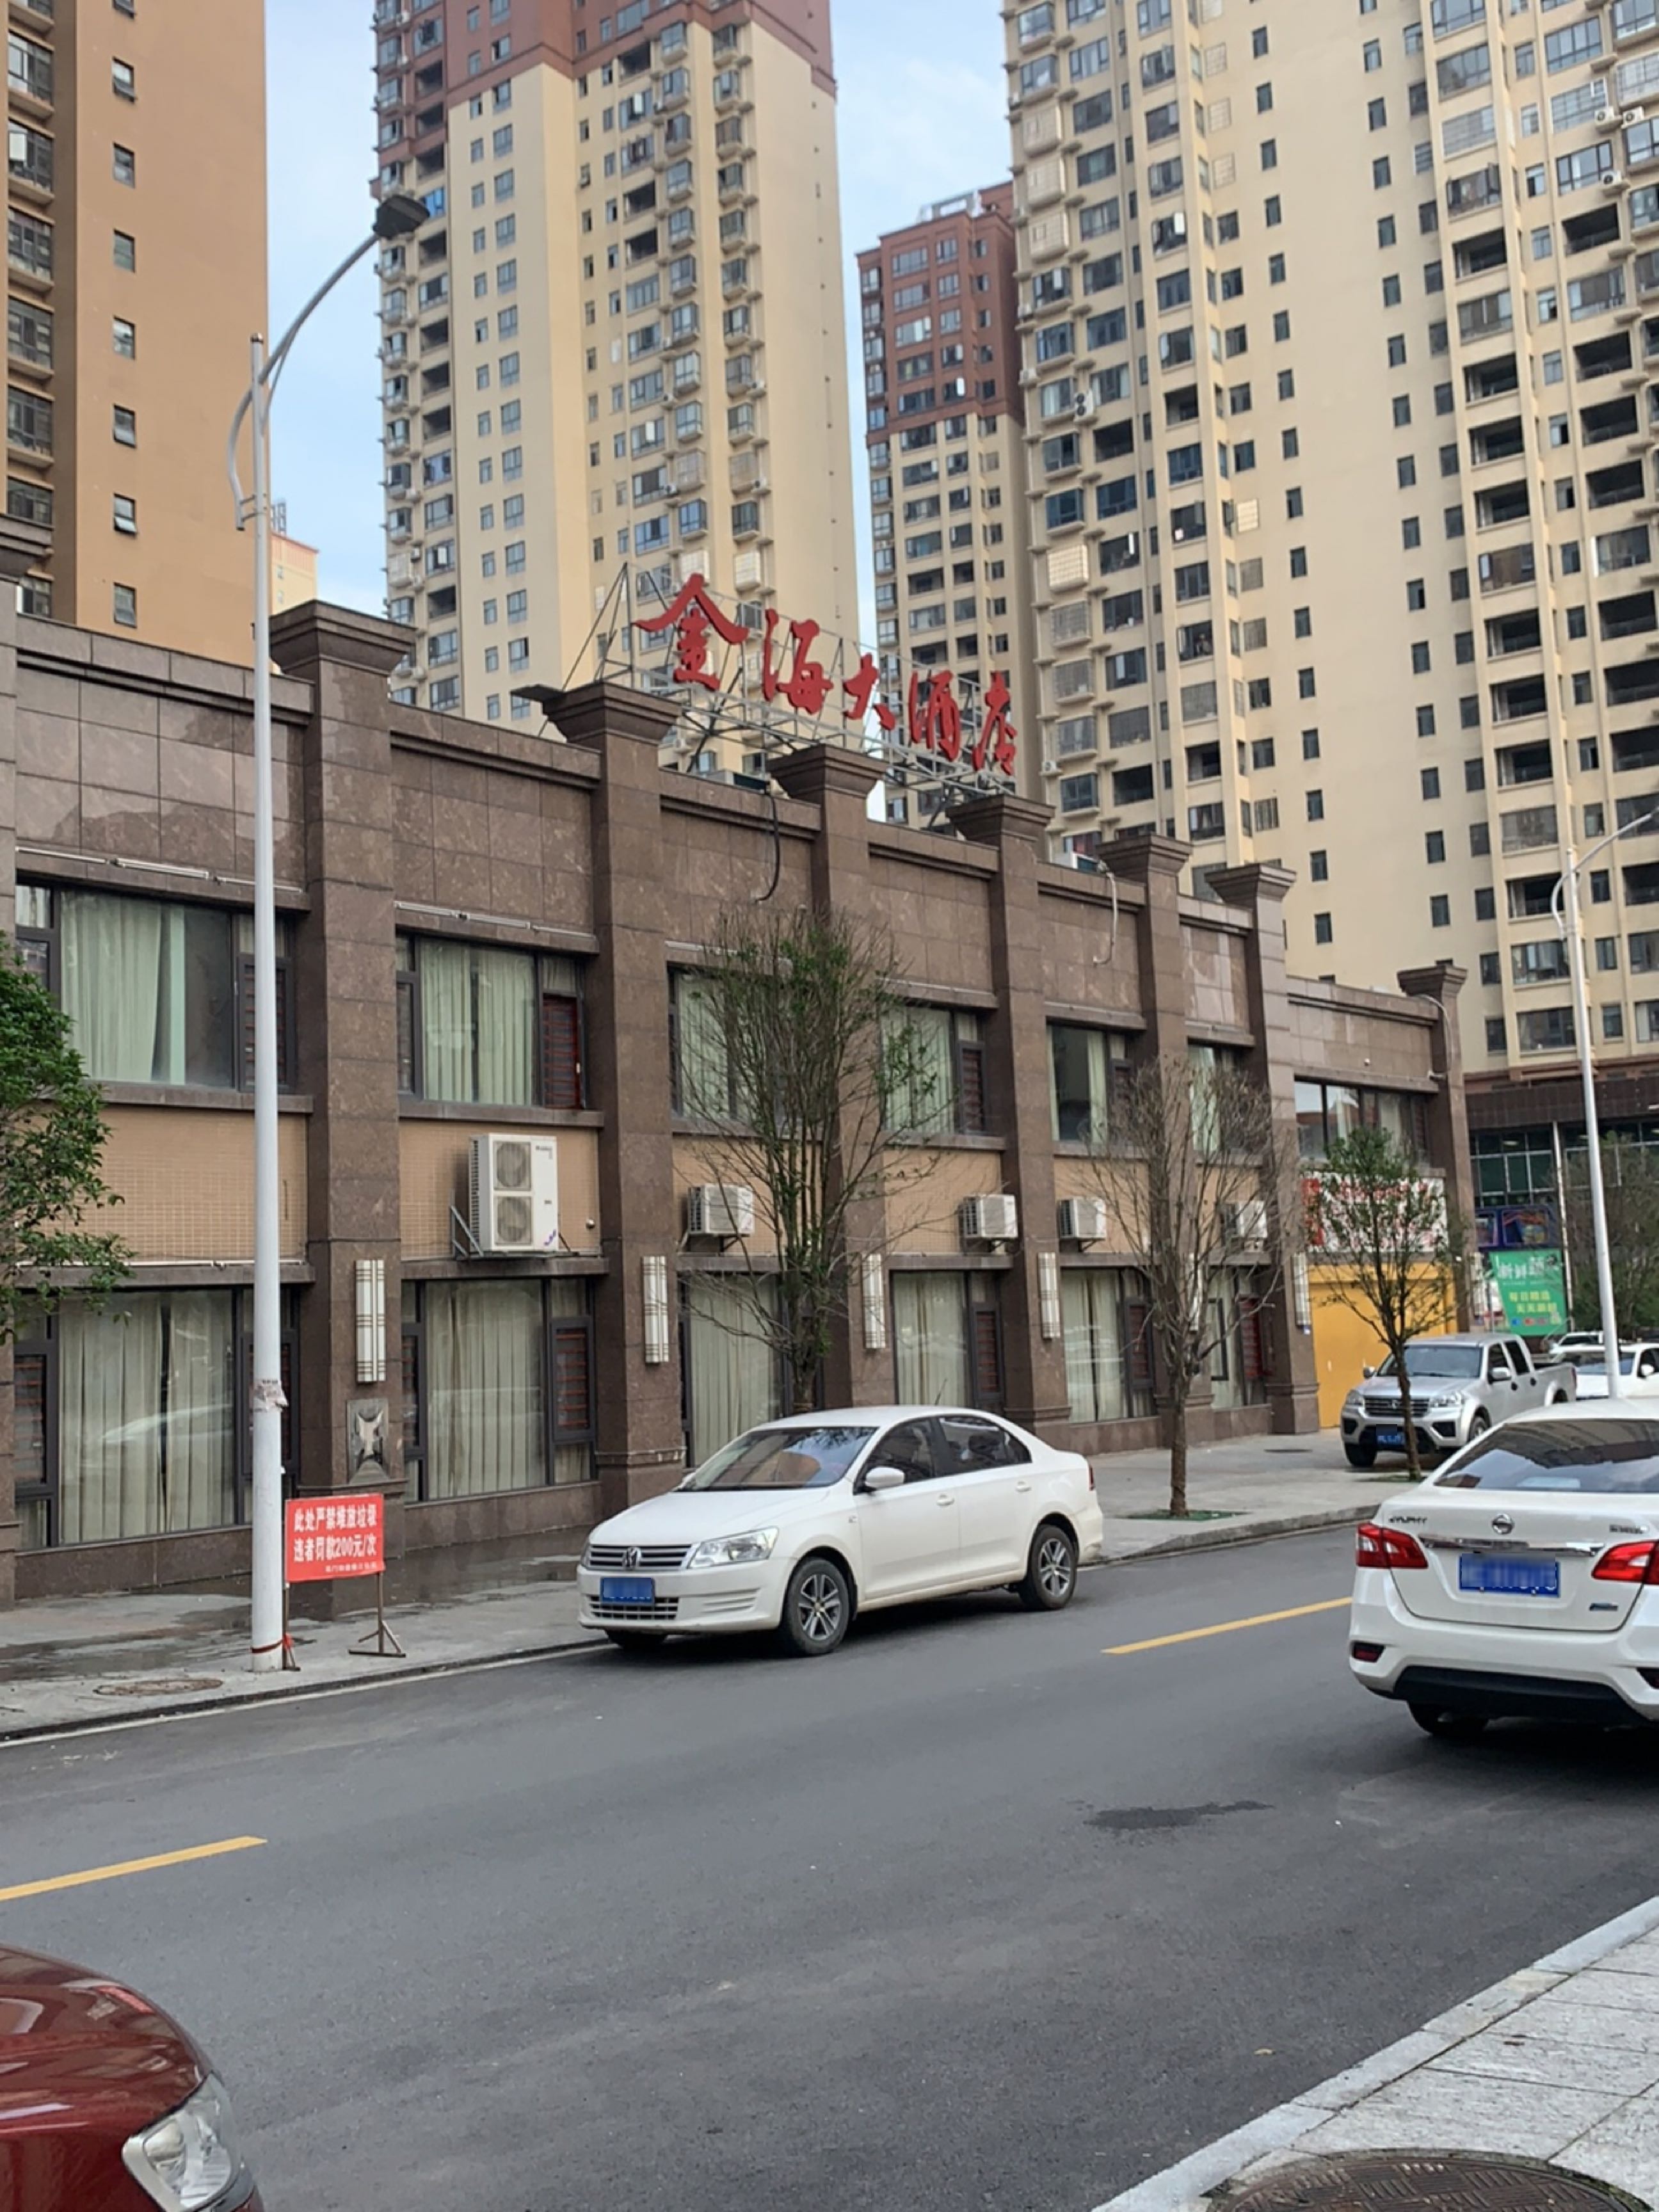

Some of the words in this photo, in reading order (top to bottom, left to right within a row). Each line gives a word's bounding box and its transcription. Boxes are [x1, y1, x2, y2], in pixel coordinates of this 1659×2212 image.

[632, 573, 1016, 776] 金海大酒店
